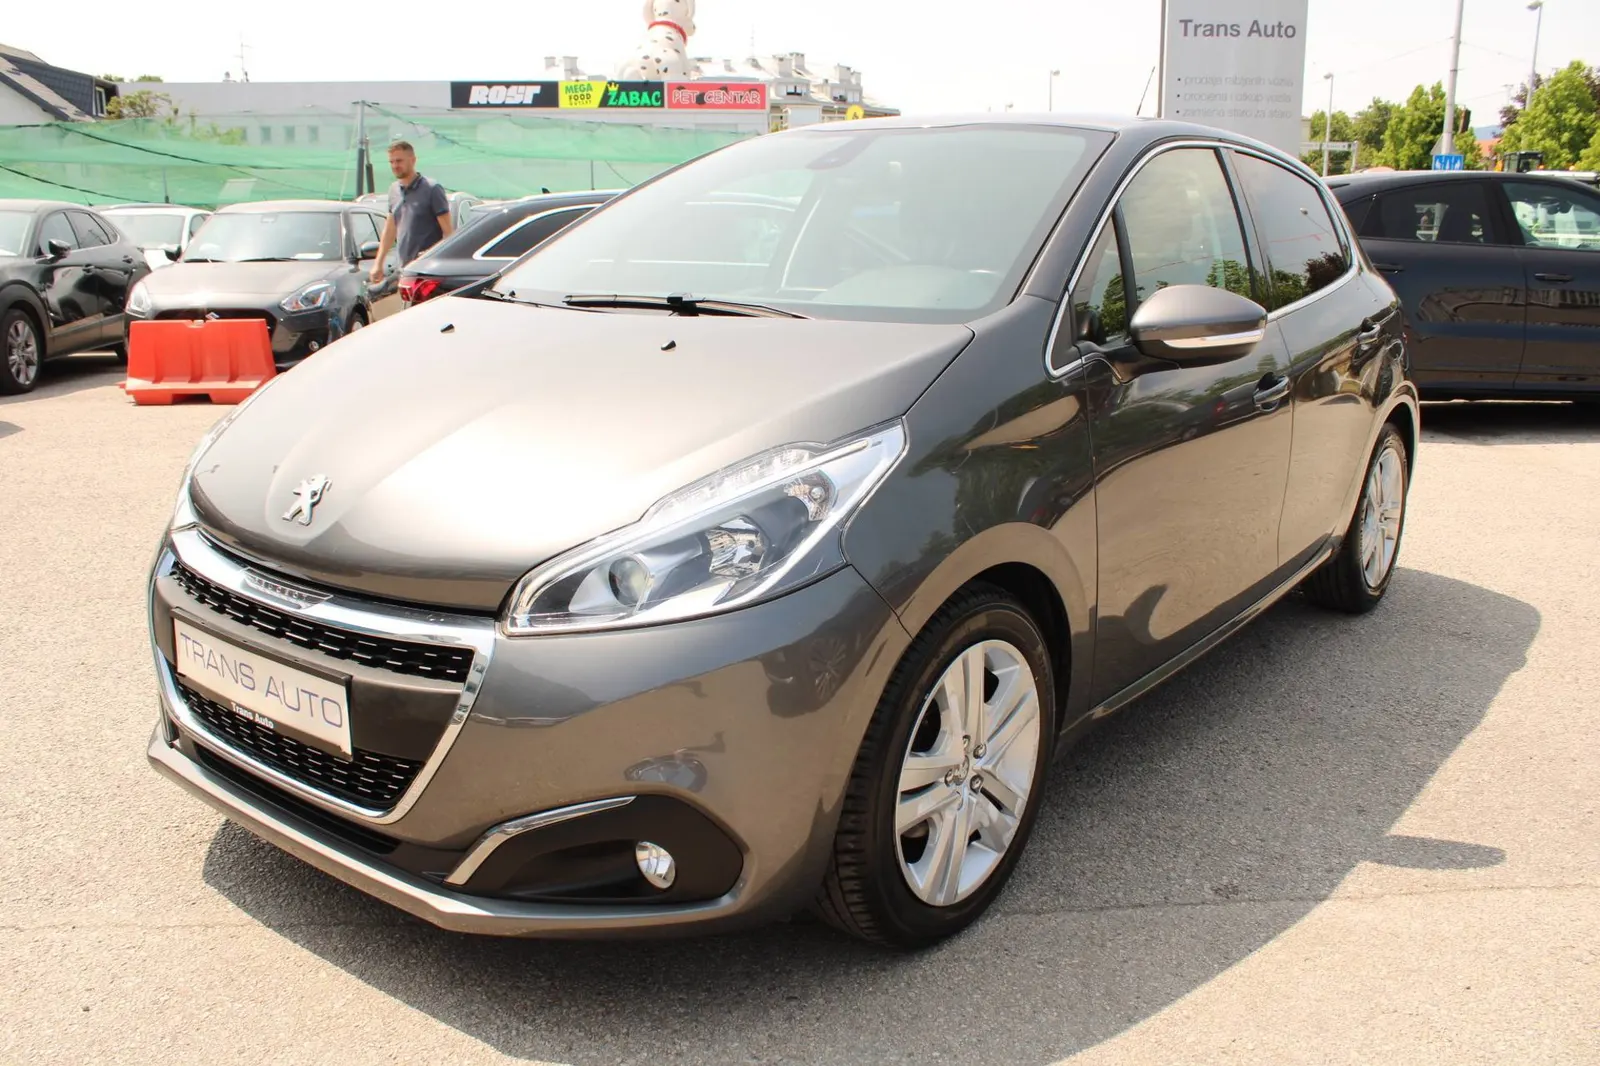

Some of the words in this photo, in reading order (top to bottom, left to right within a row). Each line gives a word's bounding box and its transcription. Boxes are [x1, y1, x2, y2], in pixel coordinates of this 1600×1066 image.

[1179, 19, 1240, 37] Trans
[1247, 20, 1296, 38] Auto
[564, 83, 593, 94] MEGA
[672, 89, 697, 104] PET
[704, 89, 760, 104] CENTAR
[568, 93, 592, 102] FOOD
[180, 632, 256, 691] TRANS
[265, 675, 343, 729] AUTO
[230, 702, 253, 721] Trans
[255, 713, 275, 729] Auto
